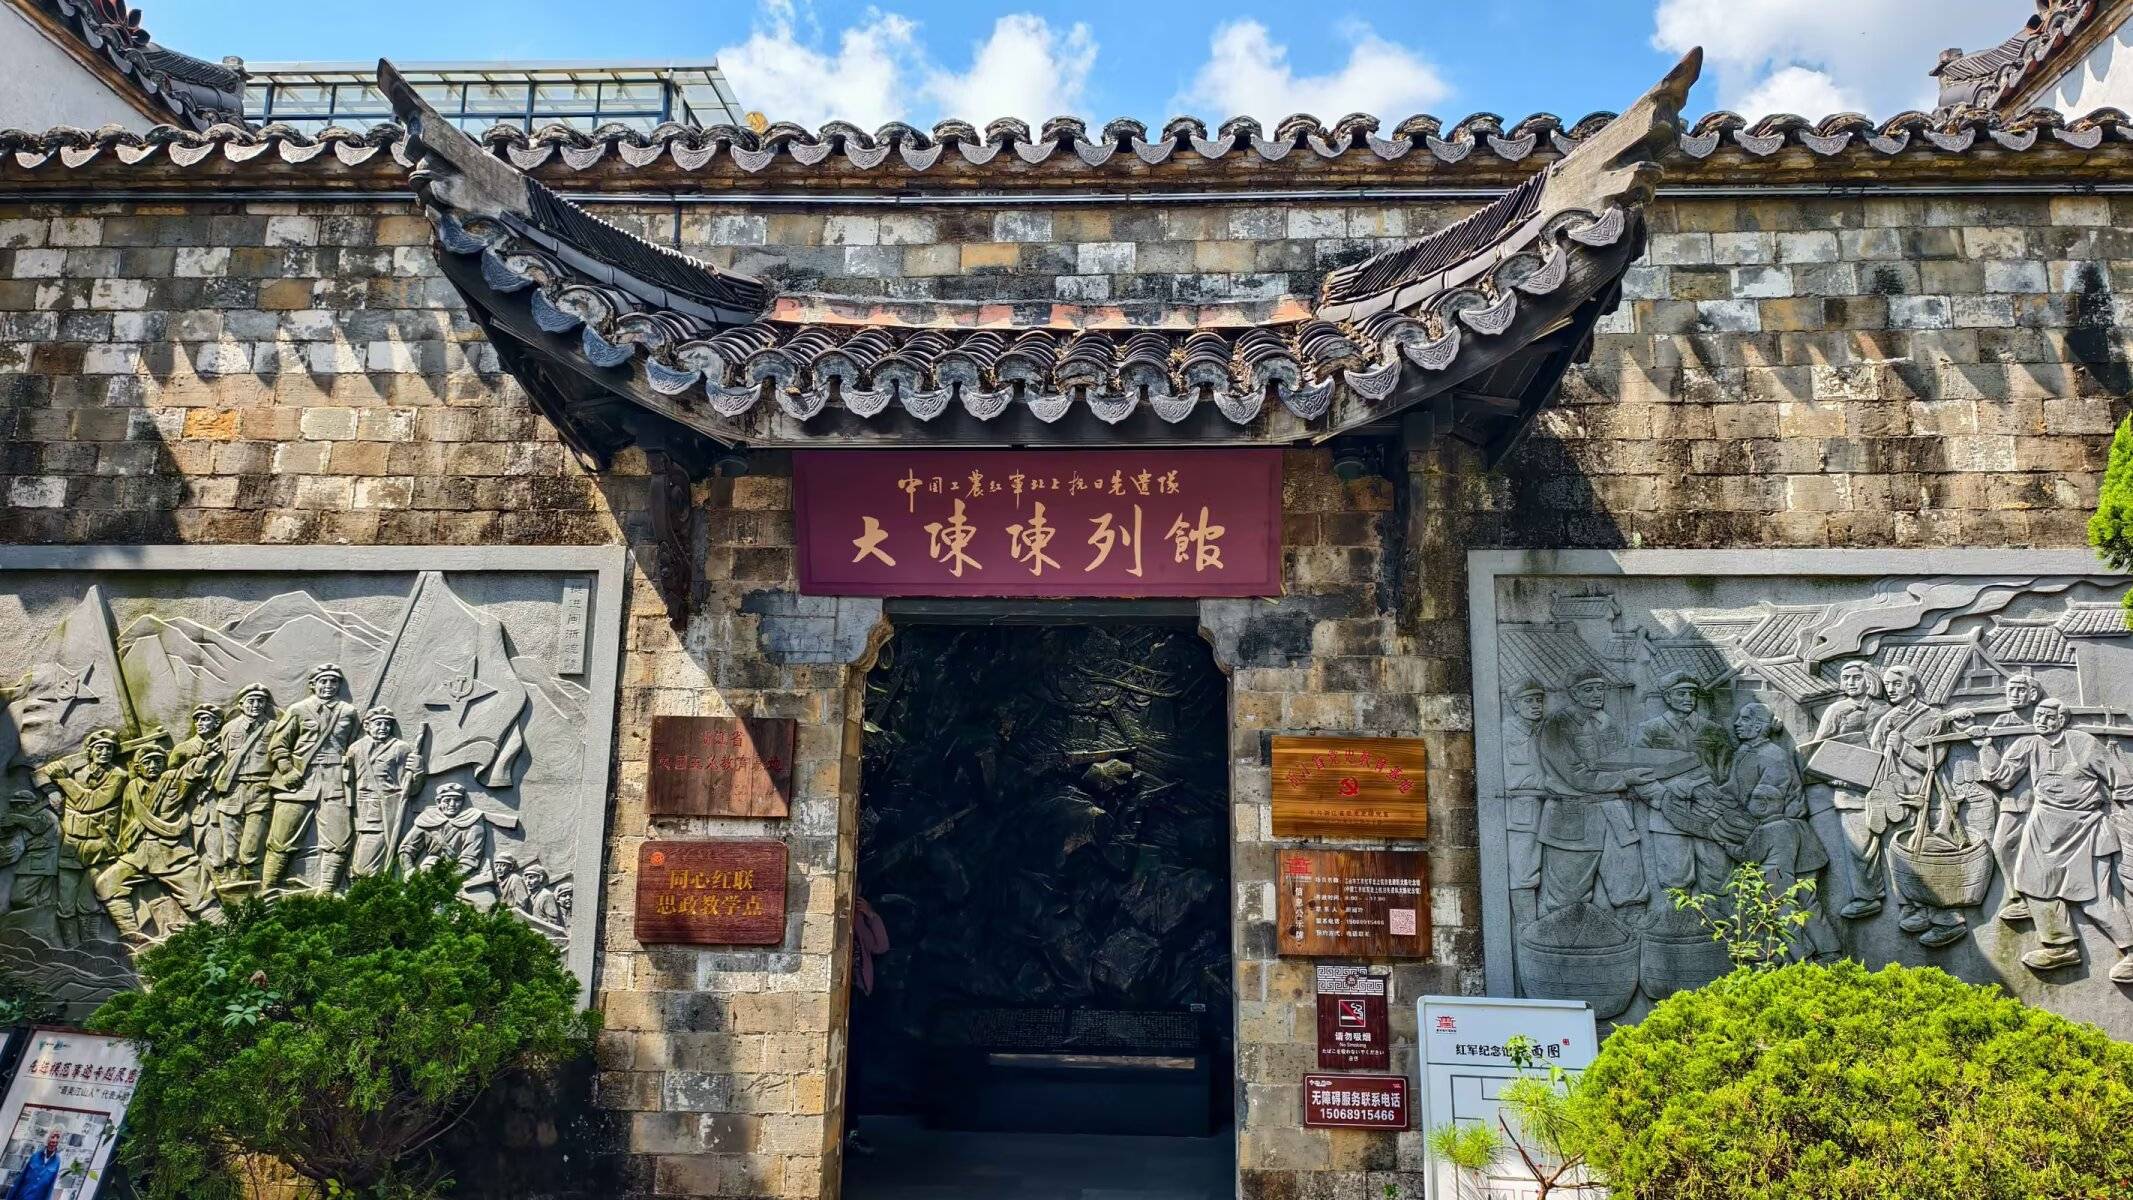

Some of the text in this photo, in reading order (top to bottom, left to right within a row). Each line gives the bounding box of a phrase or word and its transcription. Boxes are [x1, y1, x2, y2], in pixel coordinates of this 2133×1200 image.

[669, 869, 754, 889] 同心红联
[656, 895, 764, 915] 思政教学点
[1335, 1032, 1371, 1042] 请勿吸烟
[1311, 1090, 1401, 1108] 无障碍服务联系电话
[1320, 1109, 1395, 1121] 15068915466
